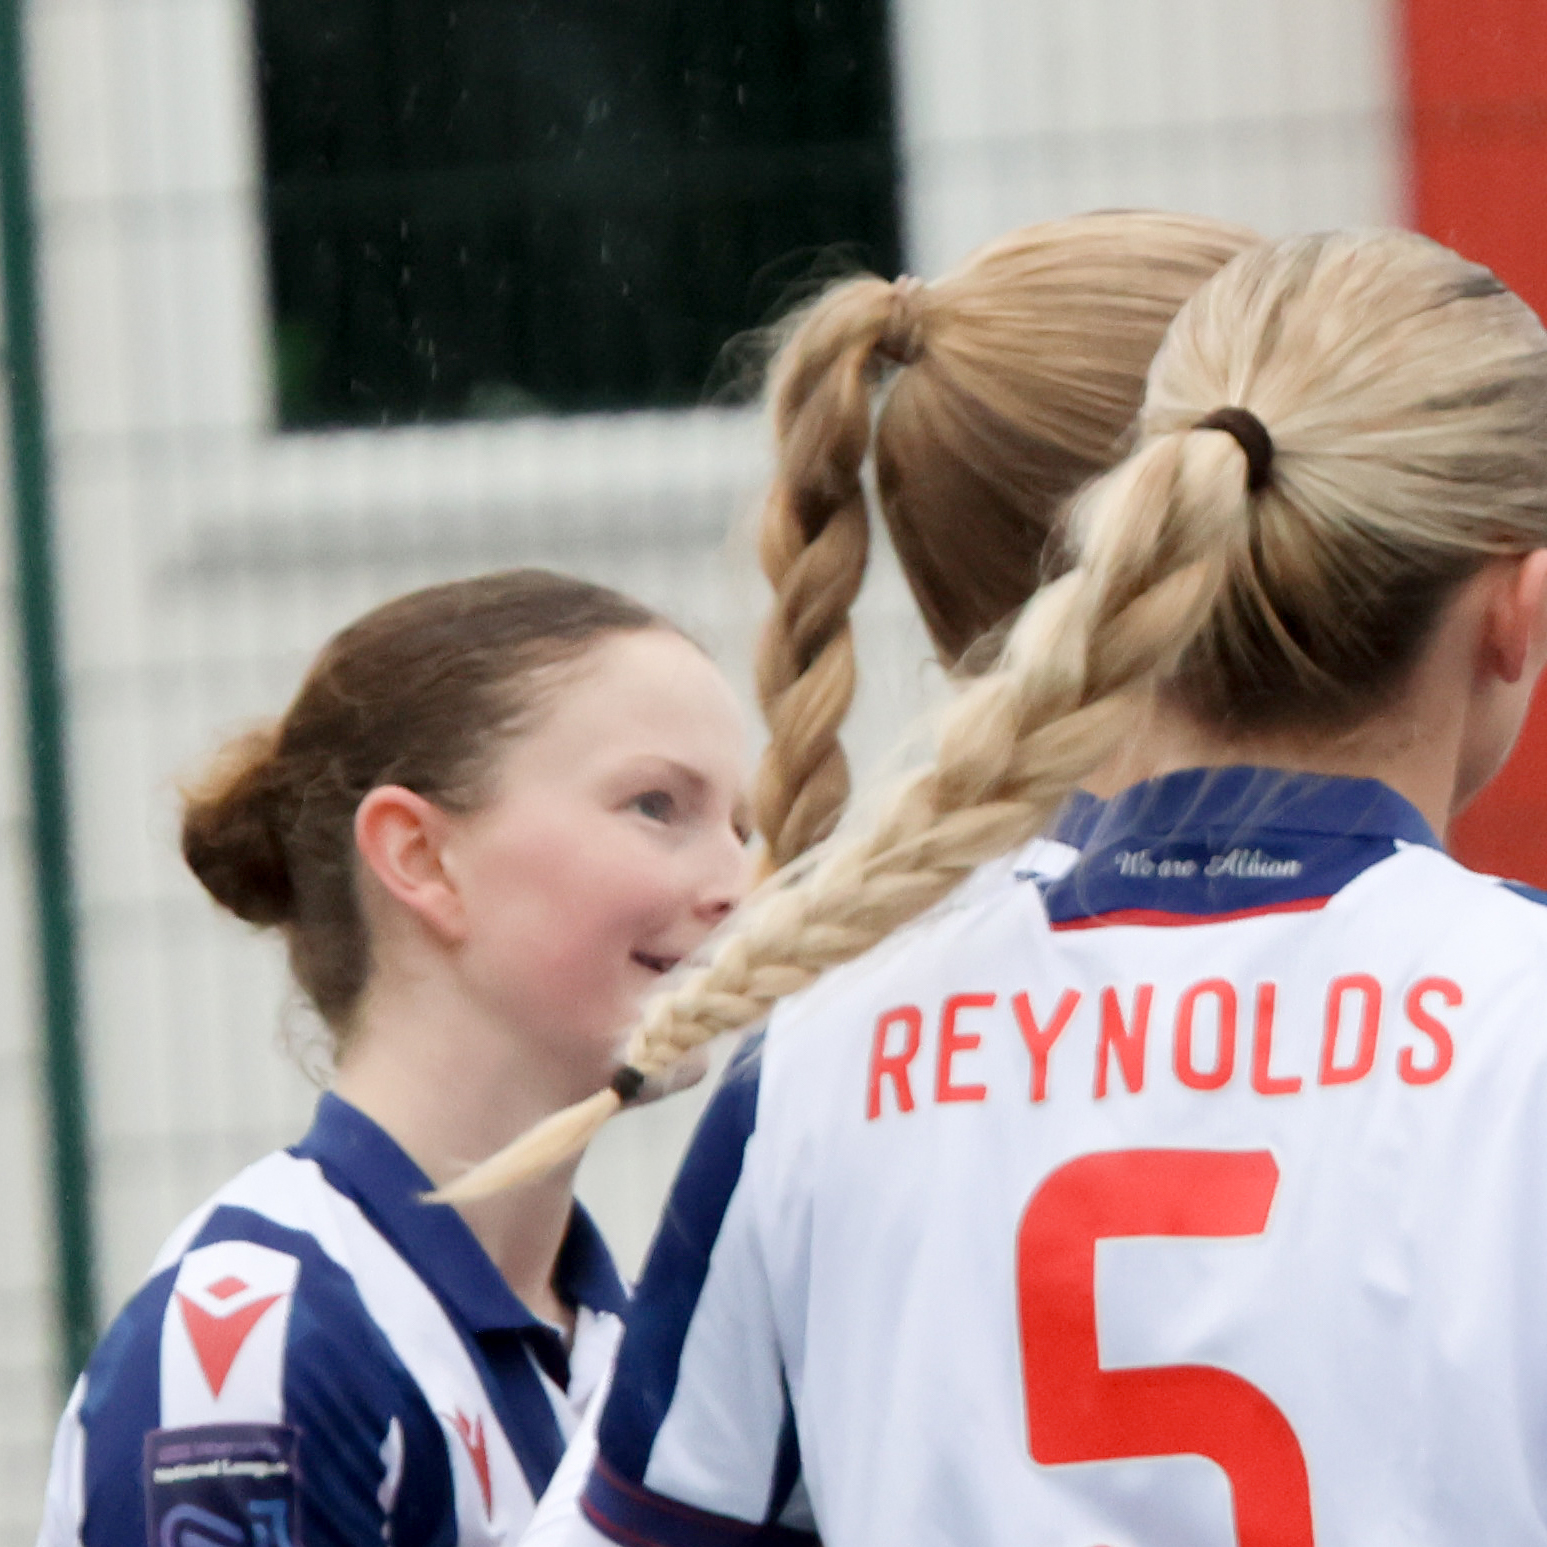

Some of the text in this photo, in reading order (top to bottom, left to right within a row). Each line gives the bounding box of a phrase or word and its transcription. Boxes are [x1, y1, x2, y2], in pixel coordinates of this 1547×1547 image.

[1115, 848, 1303, 878] We are Albion
[866, 973, 1464, 1121] REYNOLDS
